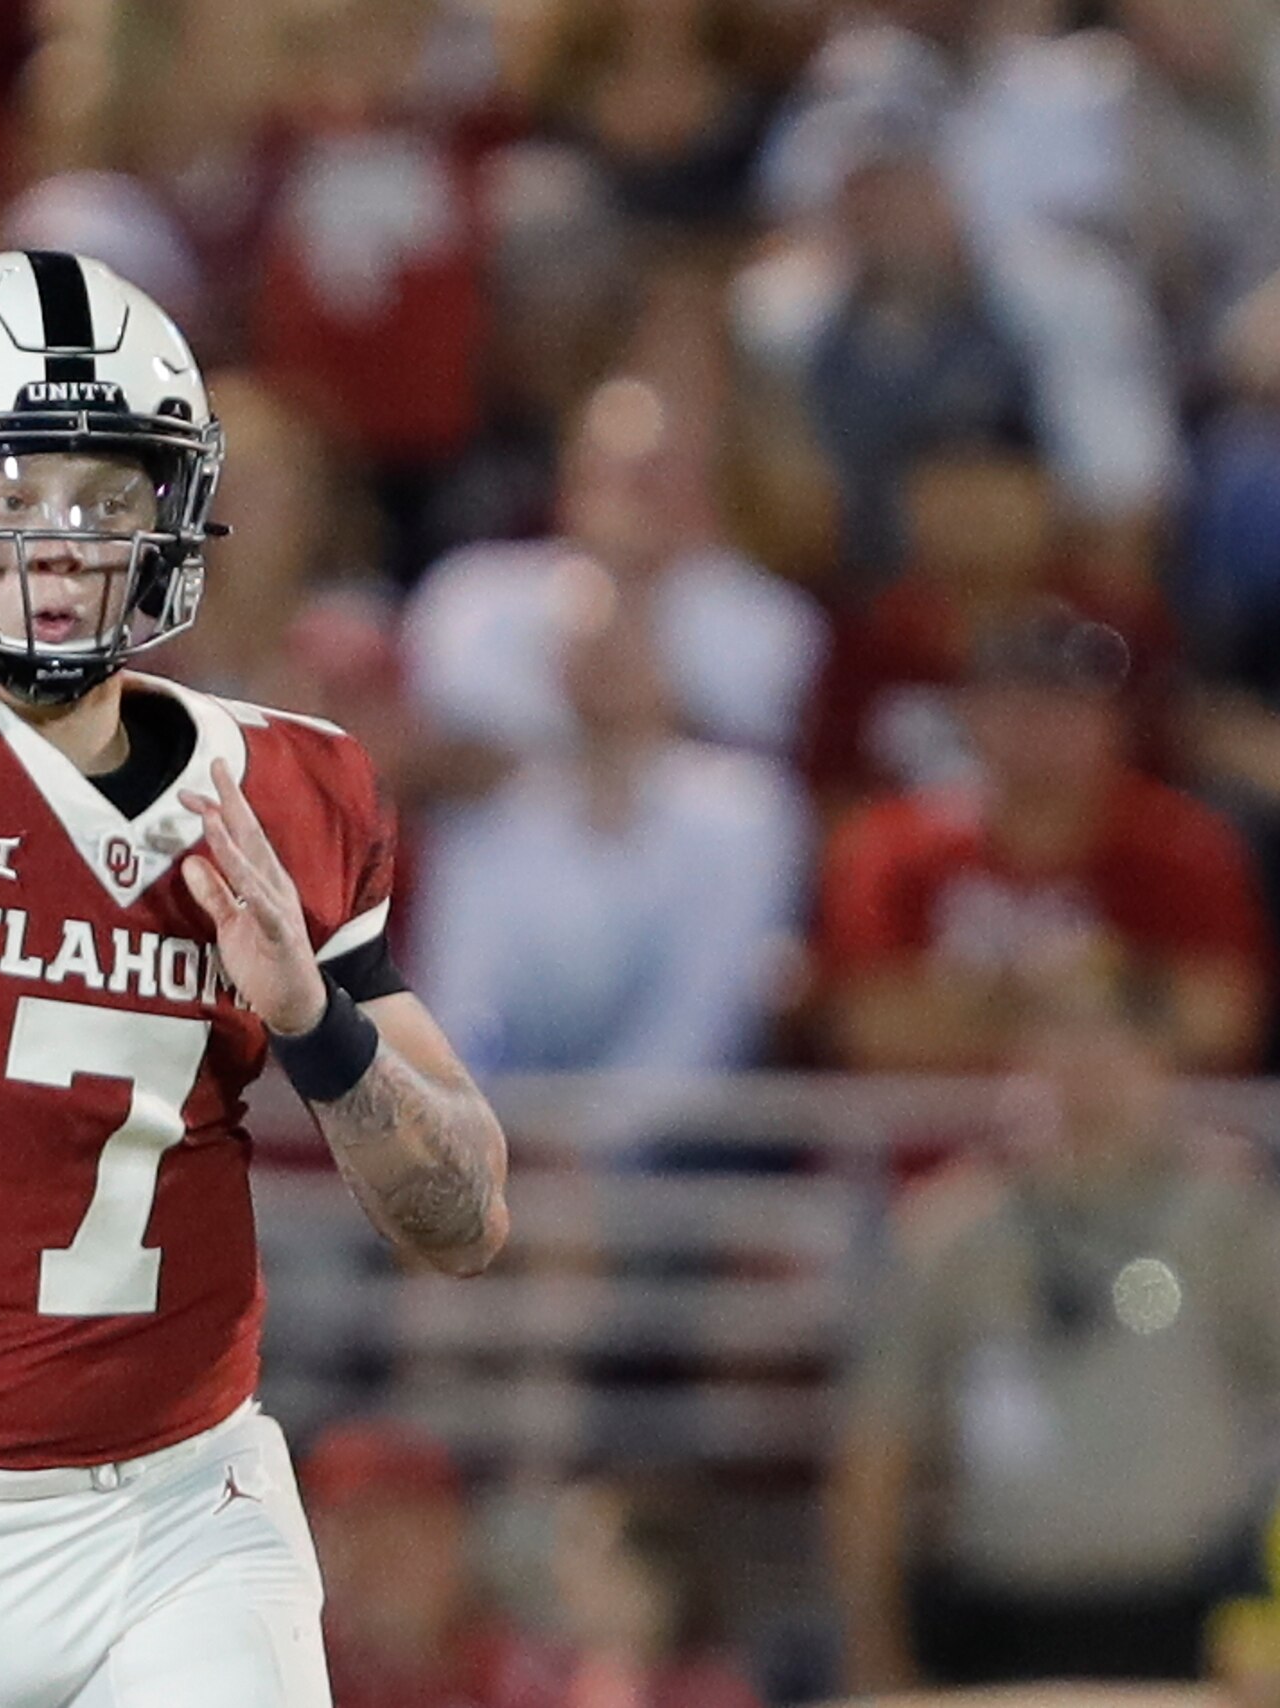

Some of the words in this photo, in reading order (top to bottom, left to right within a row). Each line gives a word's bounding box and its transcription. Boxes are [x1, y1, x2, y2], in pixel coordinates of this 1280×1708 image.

[28, 383, 119, 402] UNITY
[106, 836, 140, 889] OU
[5, 996, 212, 1316] 7
